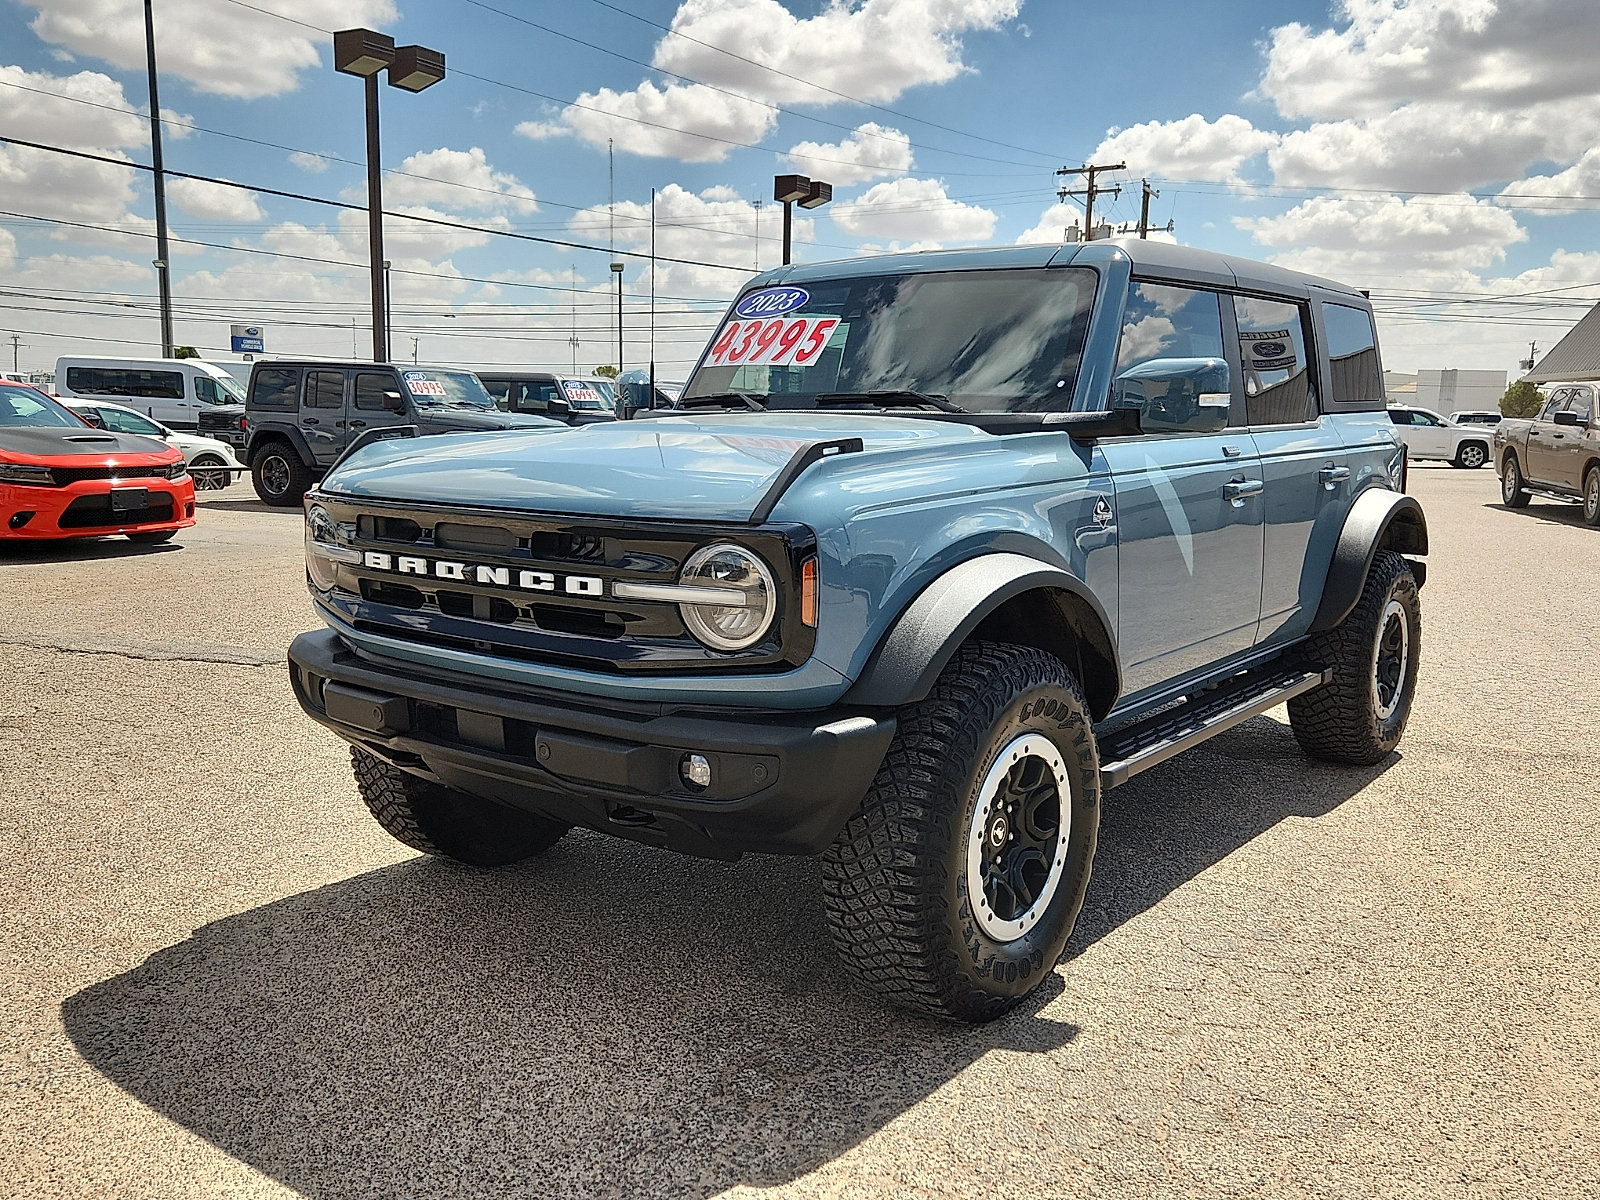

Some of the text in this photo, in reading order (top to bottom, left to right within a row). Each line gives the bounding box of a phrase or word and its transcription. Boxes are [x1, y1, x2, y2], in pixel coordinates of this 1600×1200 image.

[742, 292, 799, 314] 2023
[711, 318, 837, 364] 43995
[408, 381, 443, 394] 30995
[567, 389, 599, 400] 36995
[364, 551, 603, 596] BRONCO
